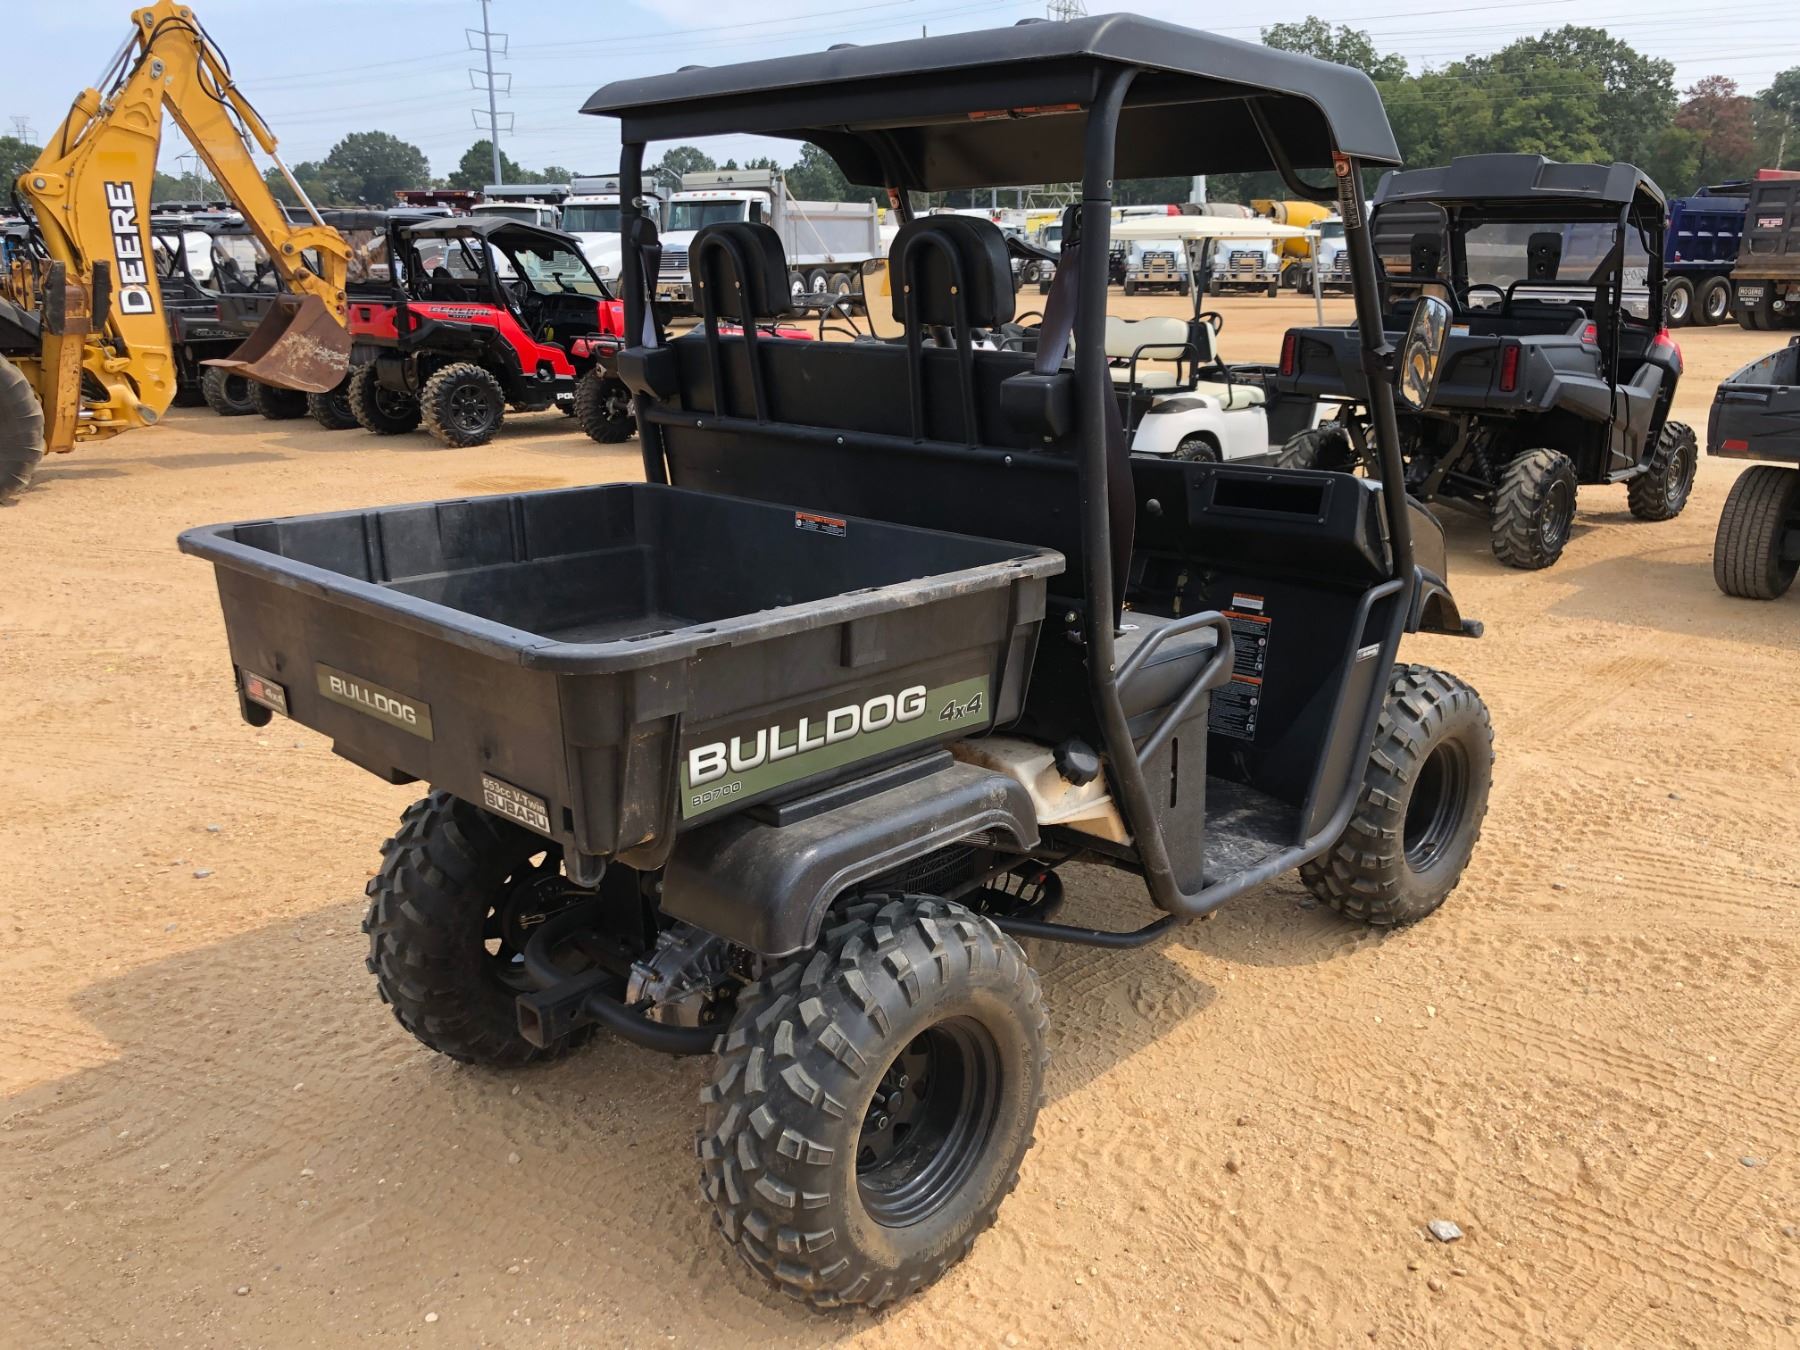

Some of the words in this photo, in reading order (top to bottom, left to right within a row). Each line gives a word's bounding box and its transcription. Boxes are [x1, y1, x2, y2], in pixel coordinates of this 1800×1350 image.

[104, 181, 155, 316] DEERE
[429, 307, 491, 316] GENERAL
[329, 675, 417, 725] BULLDOG
[938, 691, 983, 722] 4x4
[689, 685, 927, 788] BULLDOG
[482, 778, 512, 798] 653cc
[513, 790, 546, 814] V-Twin
[486, 792, 547, 830] SUBARU
